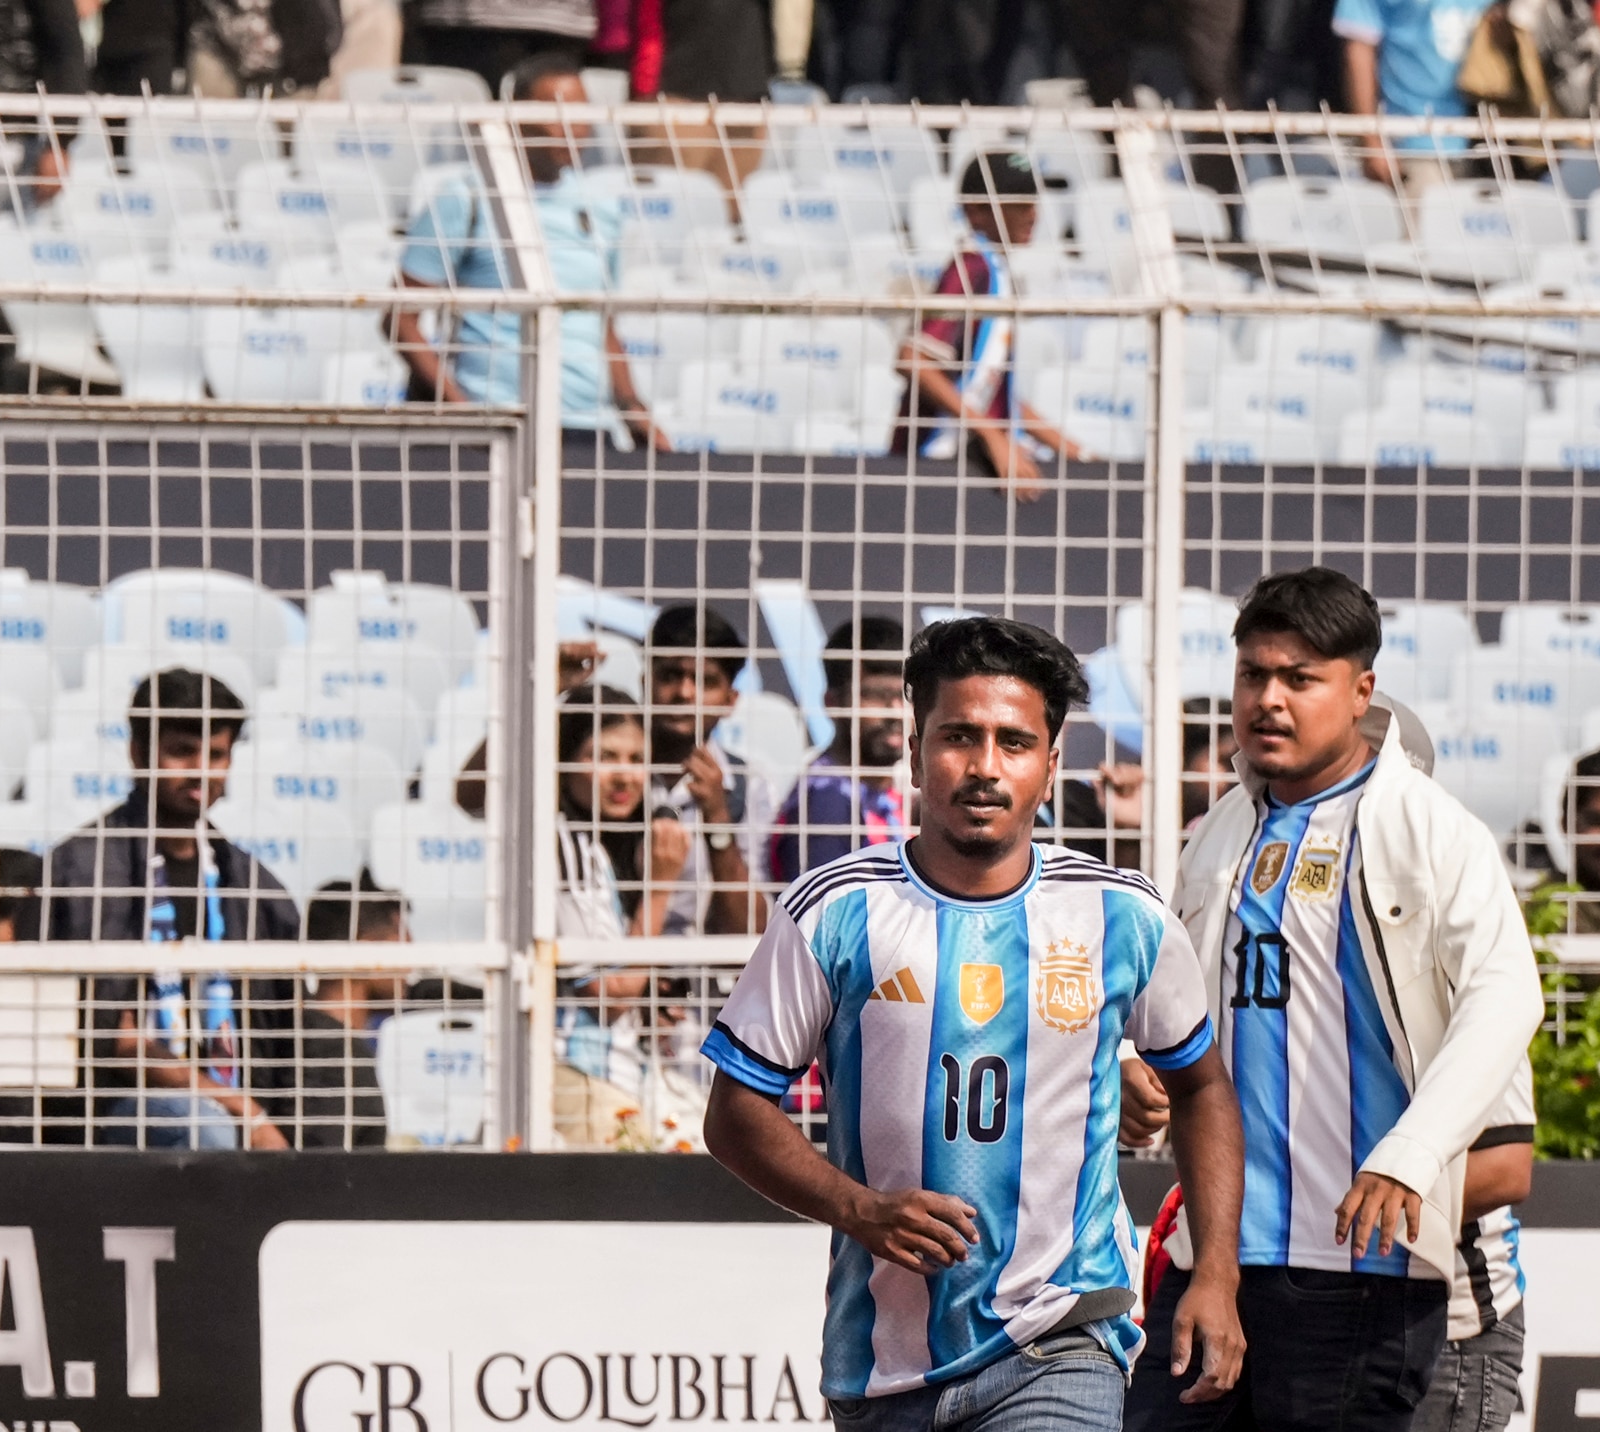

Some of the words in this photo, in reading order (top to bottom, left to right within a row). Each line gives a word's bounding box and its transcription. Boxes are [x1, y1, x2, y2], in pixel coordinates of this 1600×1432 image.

[1049, 973, 1086, 1012] AFA
[1229, 930, 1291, 1010] 10
[940, 1052, 1010, 1145] 10
